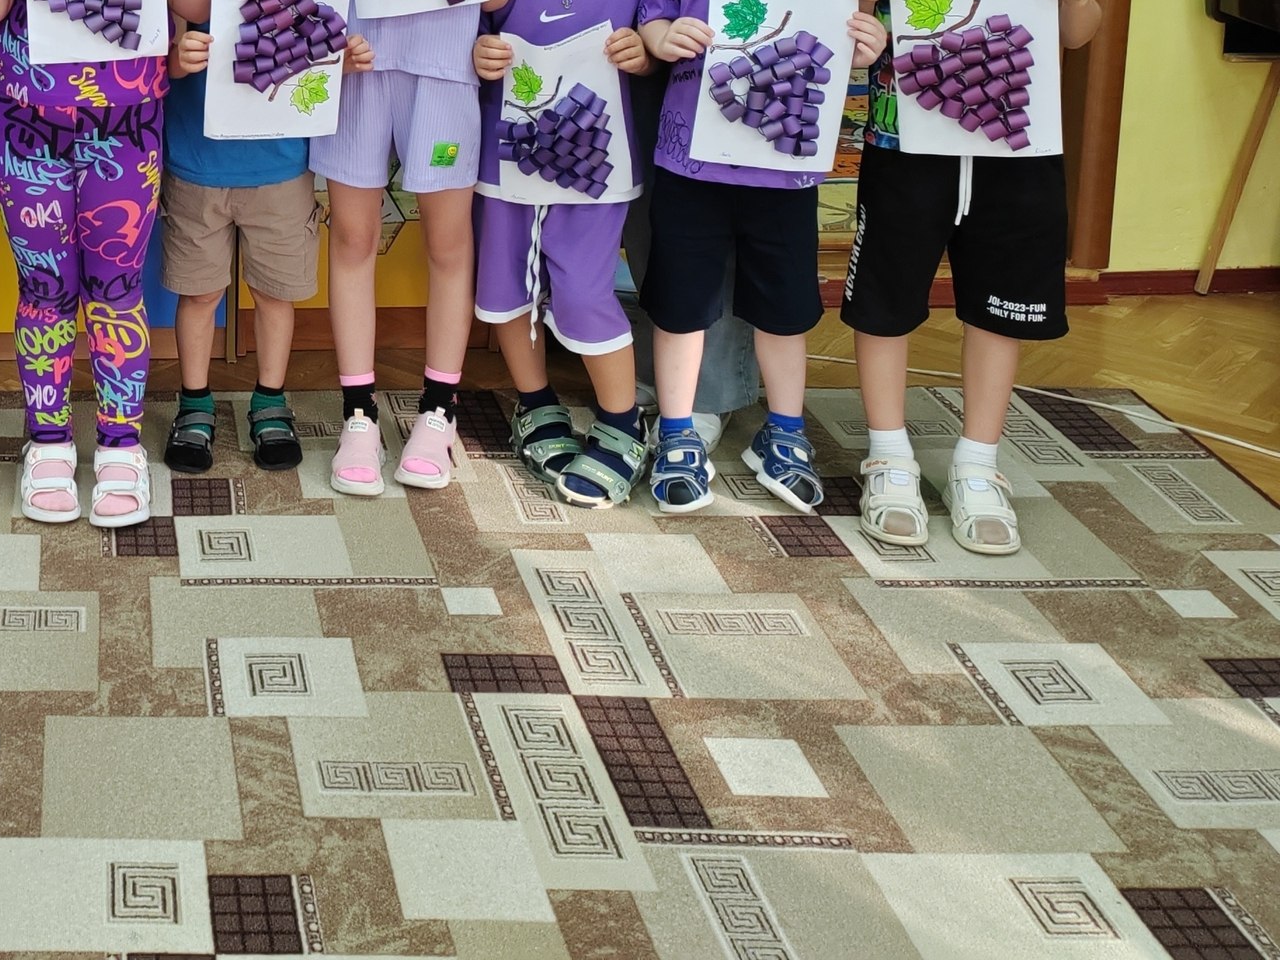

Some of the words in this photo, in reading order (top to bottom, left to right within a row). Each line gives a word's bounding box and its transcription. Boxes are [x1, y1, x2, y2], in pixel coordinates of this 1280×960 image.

[987, 294, 1046, 313] JOI-2023-FUN
[986, 306, 1009, 319] -ONLY
[1010, 311, 1026, 322] FOR
[1027, 313, 1047, 323] FUN-
